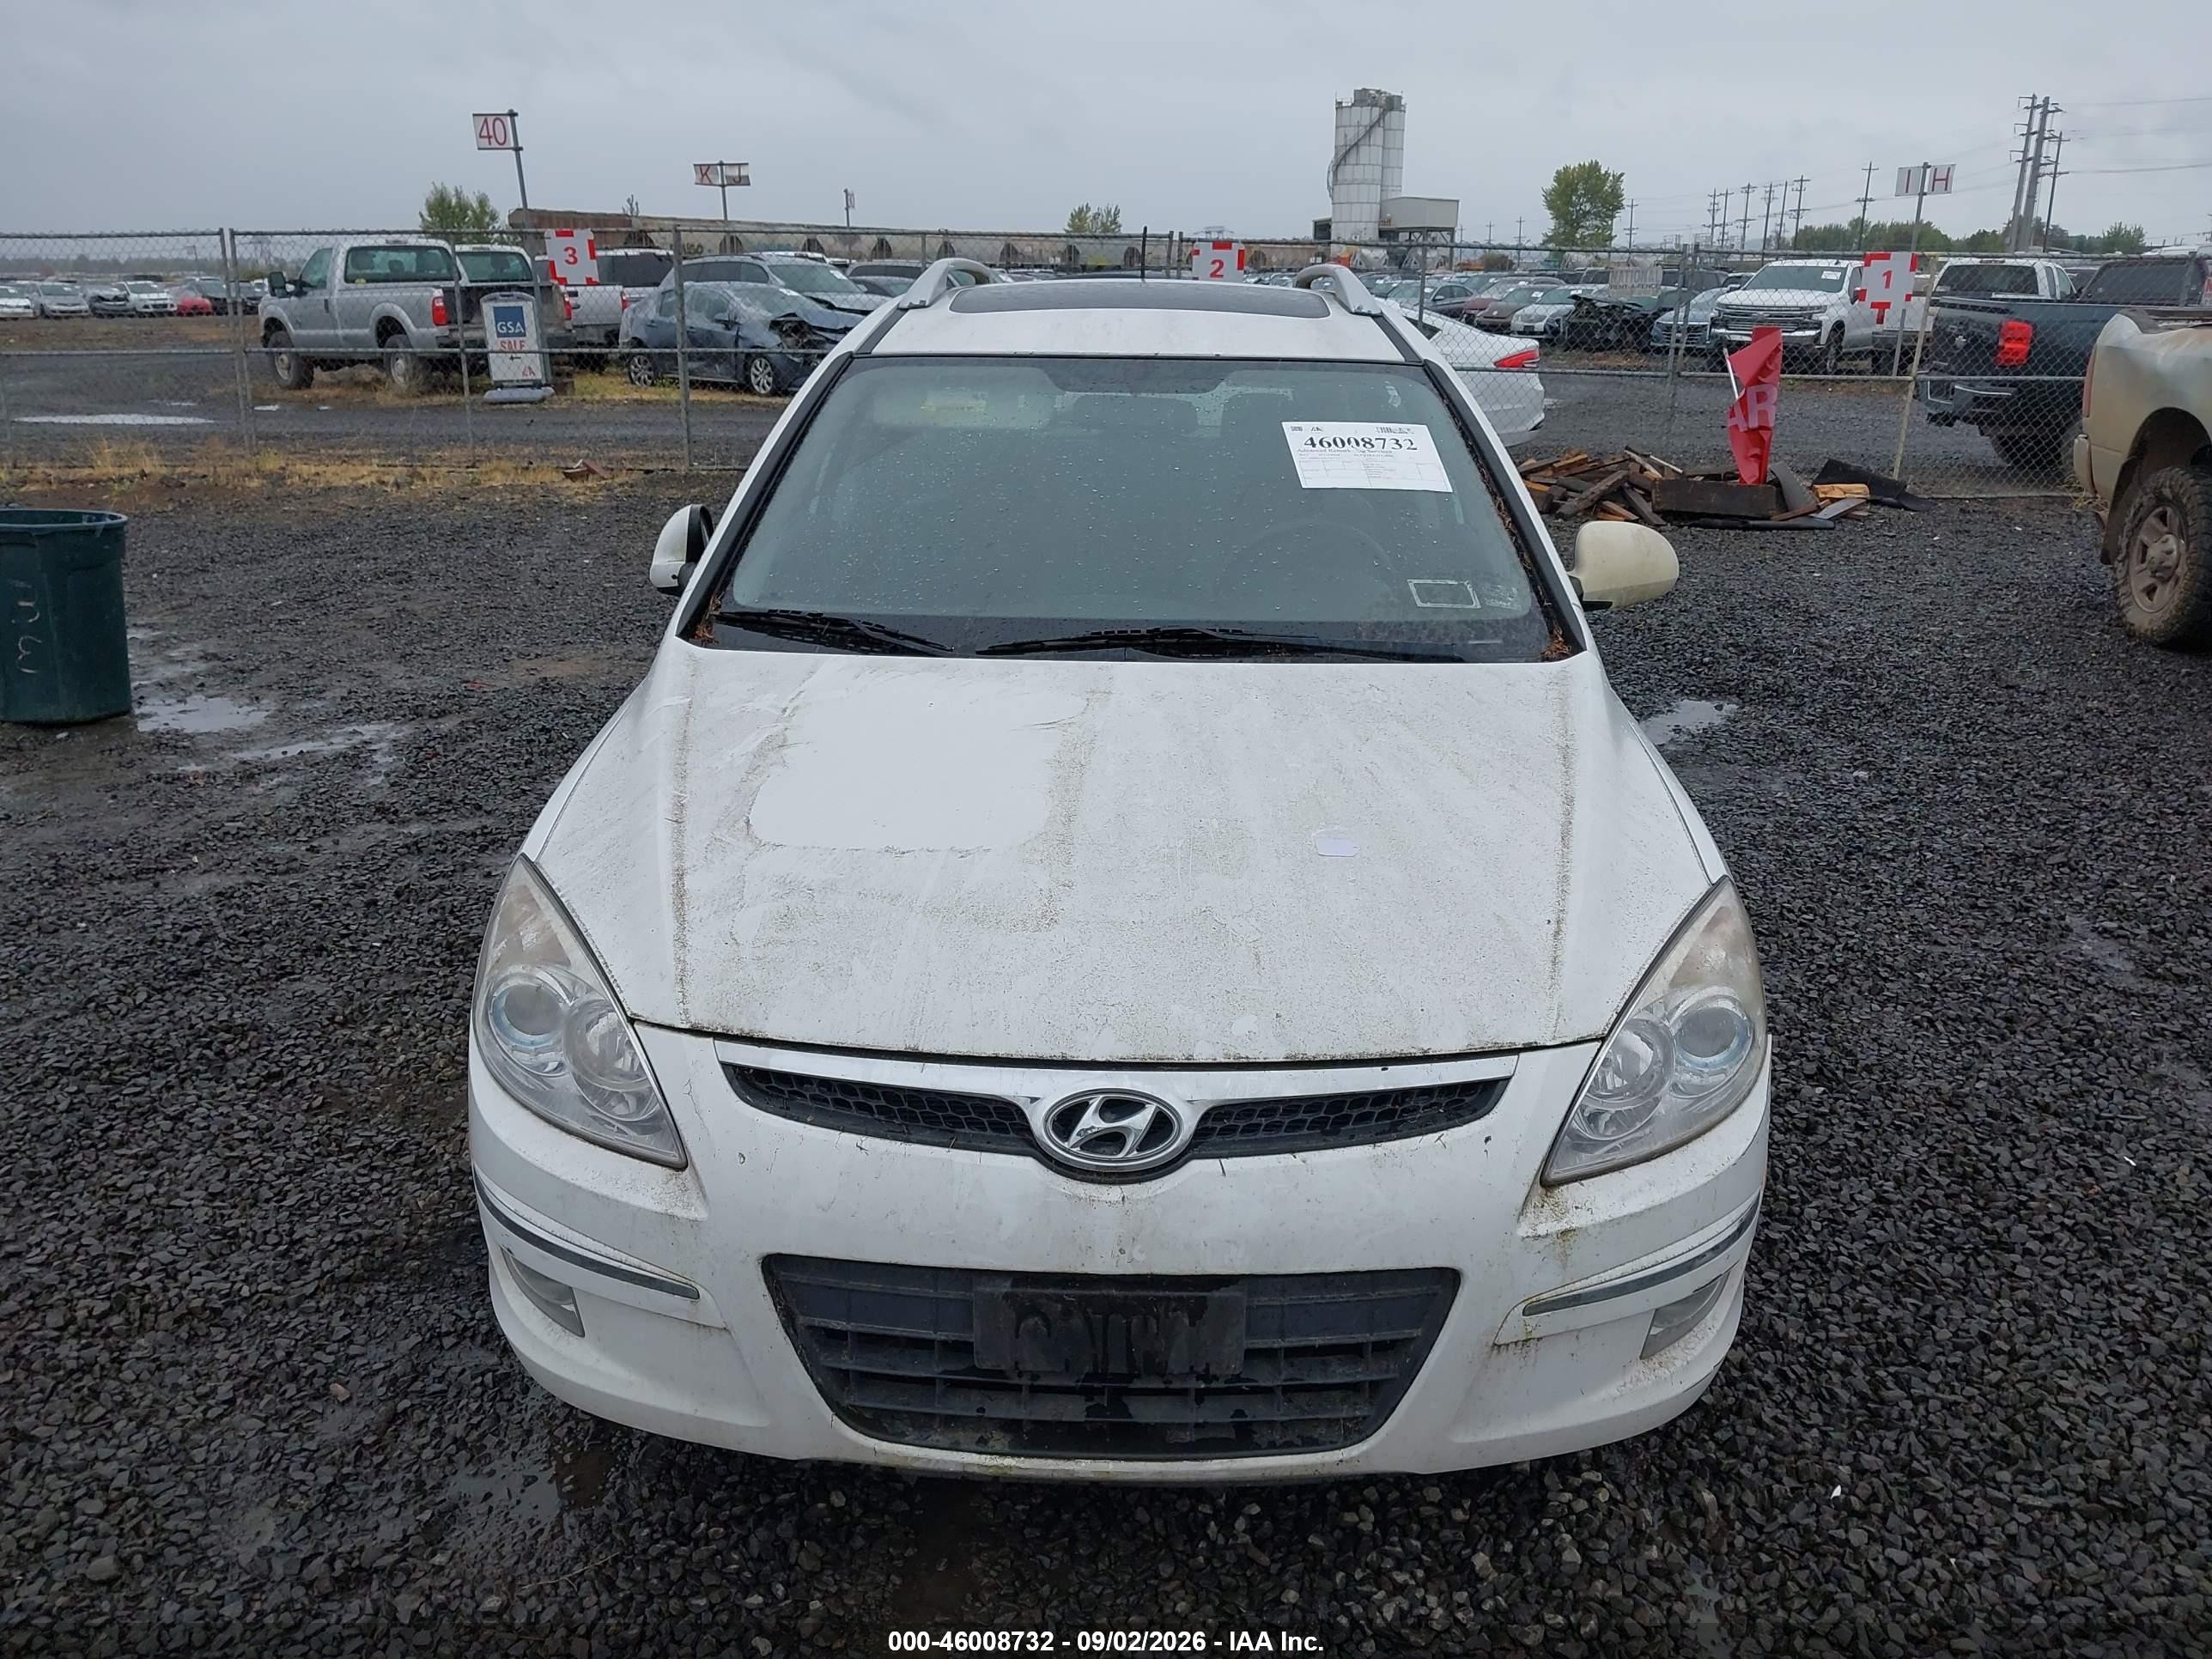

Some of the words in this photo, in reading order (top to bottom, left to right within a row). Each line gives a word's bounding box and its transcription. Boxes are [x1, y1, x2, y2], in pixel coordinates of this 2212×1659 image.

[478, 117, 507, 146] 40
[699, 164, 714, 185] K
[732, 164, 742, 184] J
[1931, 167, 1951, 192] H
[563, 246, 578, 265] 3
[1209, 259, 1224, 279] 2
[1882, 270, 1893, 289] 1
[497, 321, 525, 334] GSA
[500, 340, 526, 350] SALE
[1304, 435, 1418, 451] 46008732
